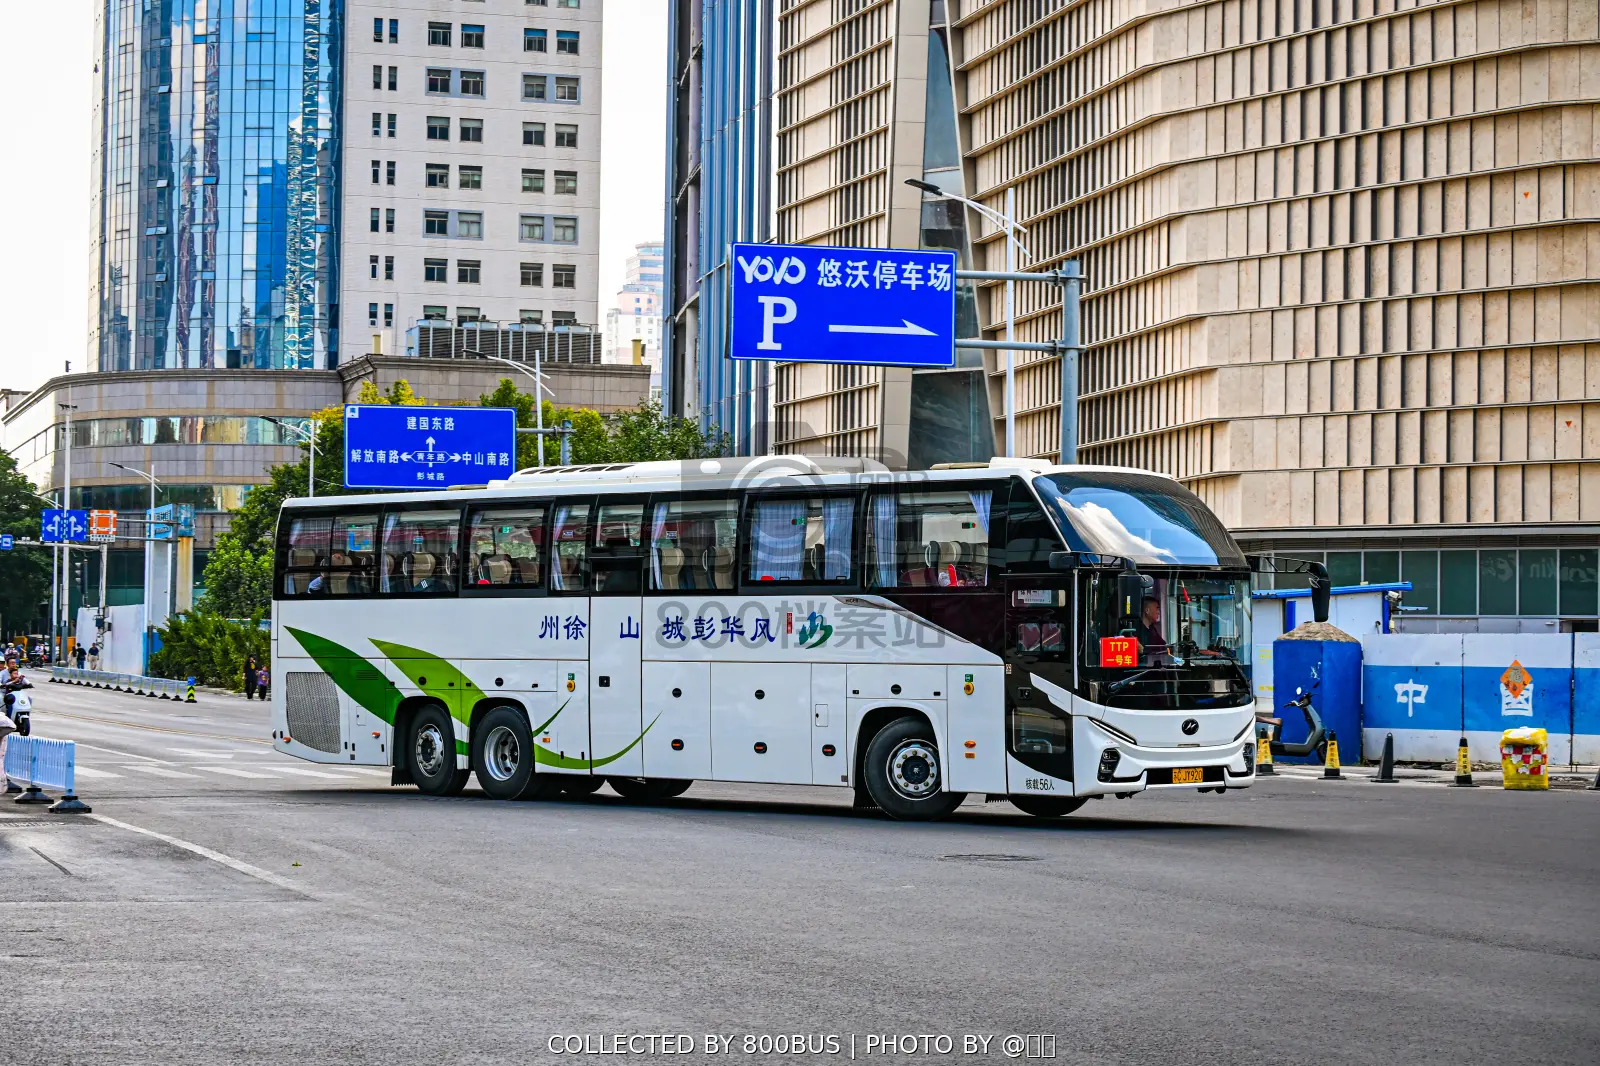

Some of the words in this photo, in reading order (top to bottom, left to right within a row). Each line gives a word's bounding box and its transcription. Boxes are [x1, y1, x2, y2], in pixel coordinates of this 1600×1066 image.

[817, 258, 952, 292] 悠沃停车场
[756, 295, 798, 351] P
[406, 416, 455, 431] 建国东路
[351, 449, 400, 464] 解放南路
[416, 452, 446, 462] 青年路
[462, 451, 510, 466] 中山南路
[416, 472, 446, 481] 彭城路
[1109, 641, 1129, 652] TTP
[1106, 654, 1133, 666] 一号车
[1025, 777, 1055, 791] 核载56人
